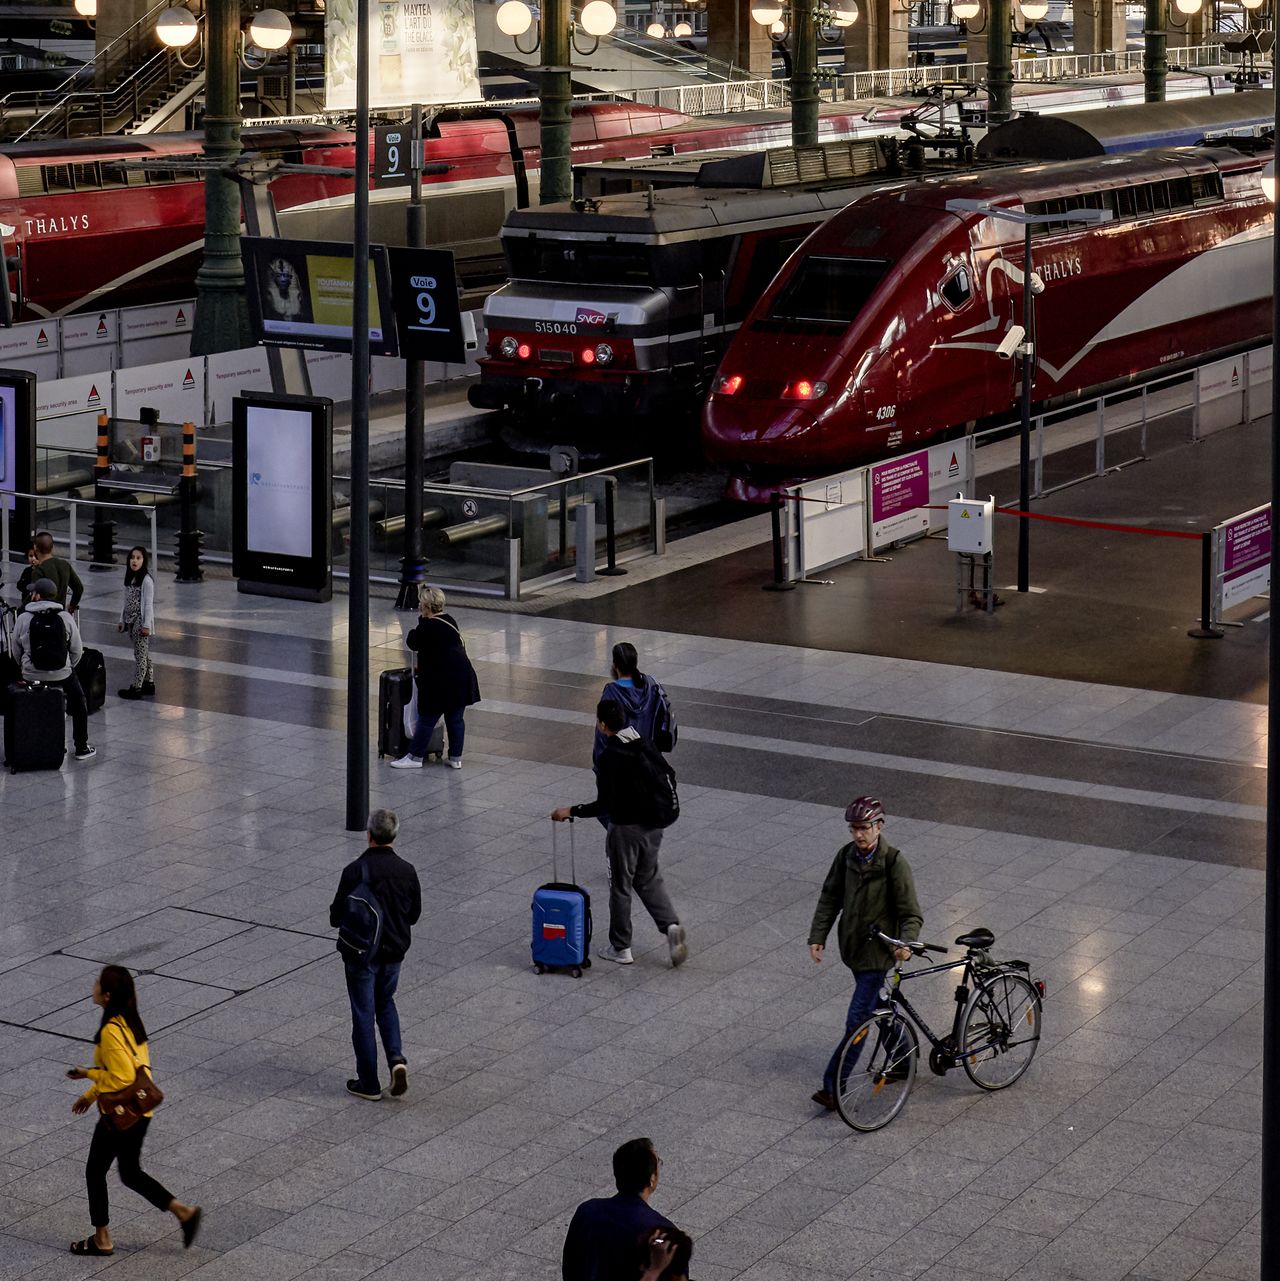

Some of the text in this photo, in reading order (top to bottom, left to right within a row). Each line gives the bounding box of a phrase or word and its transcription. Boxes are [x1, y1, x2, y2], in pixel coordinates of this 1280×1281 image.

[404, 4, 431, 16] MAYTEA
[405, 17, 420, 29] L'ART
[388, 146, 399, 172] 9
[25, 214, 88, 235] THALYS
[1036, 258, 1081, 281] THALYS
[413, 277, 433, 287] Voie
[416, 292, 435, 324] 9
[576, 314, 604, 324] SNCF
[535, 321, 576, 334] 515040
[876, 405, 896, 420] 4306
